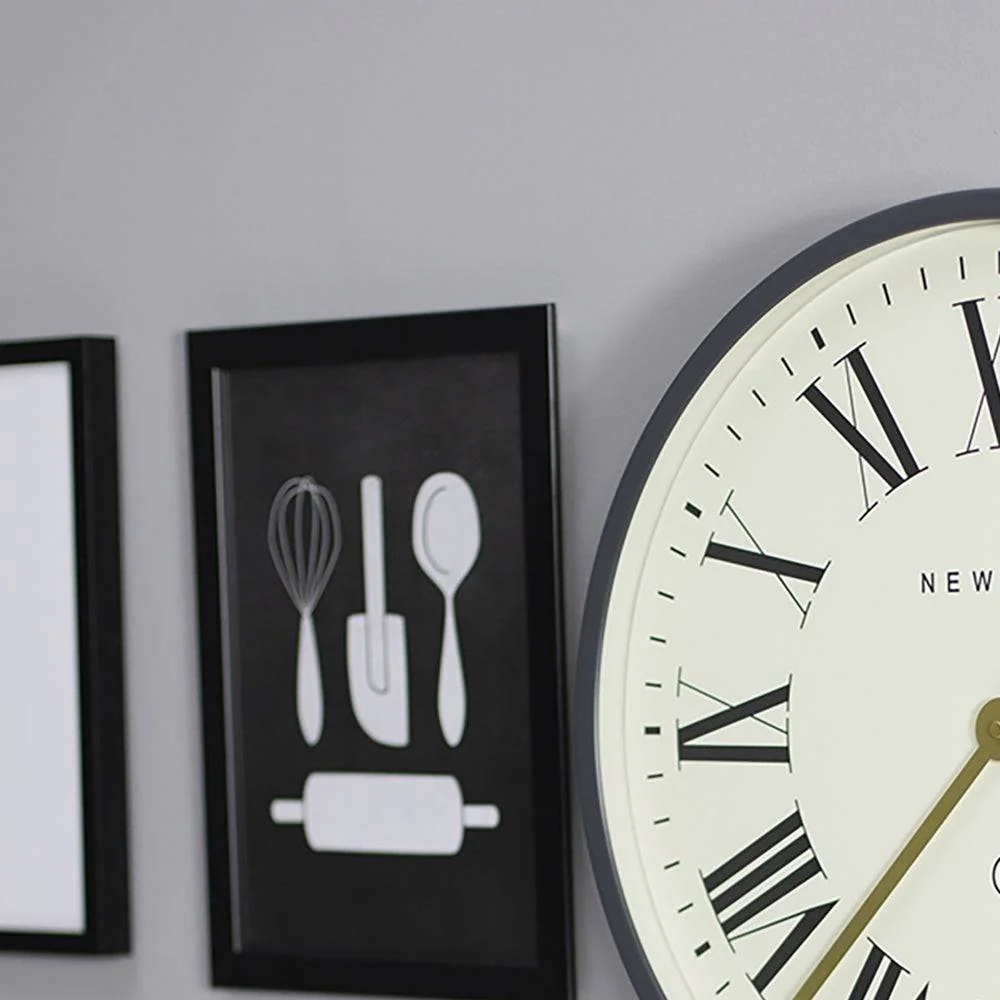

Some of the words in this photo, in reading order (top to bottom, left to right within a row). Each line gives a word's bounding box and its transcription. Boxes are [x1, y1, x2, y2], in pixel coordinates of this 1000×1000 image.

[796, 341, 929, 521] XI
[701, 489, 831, 629] X
[678, 666, 792, 773] IX
